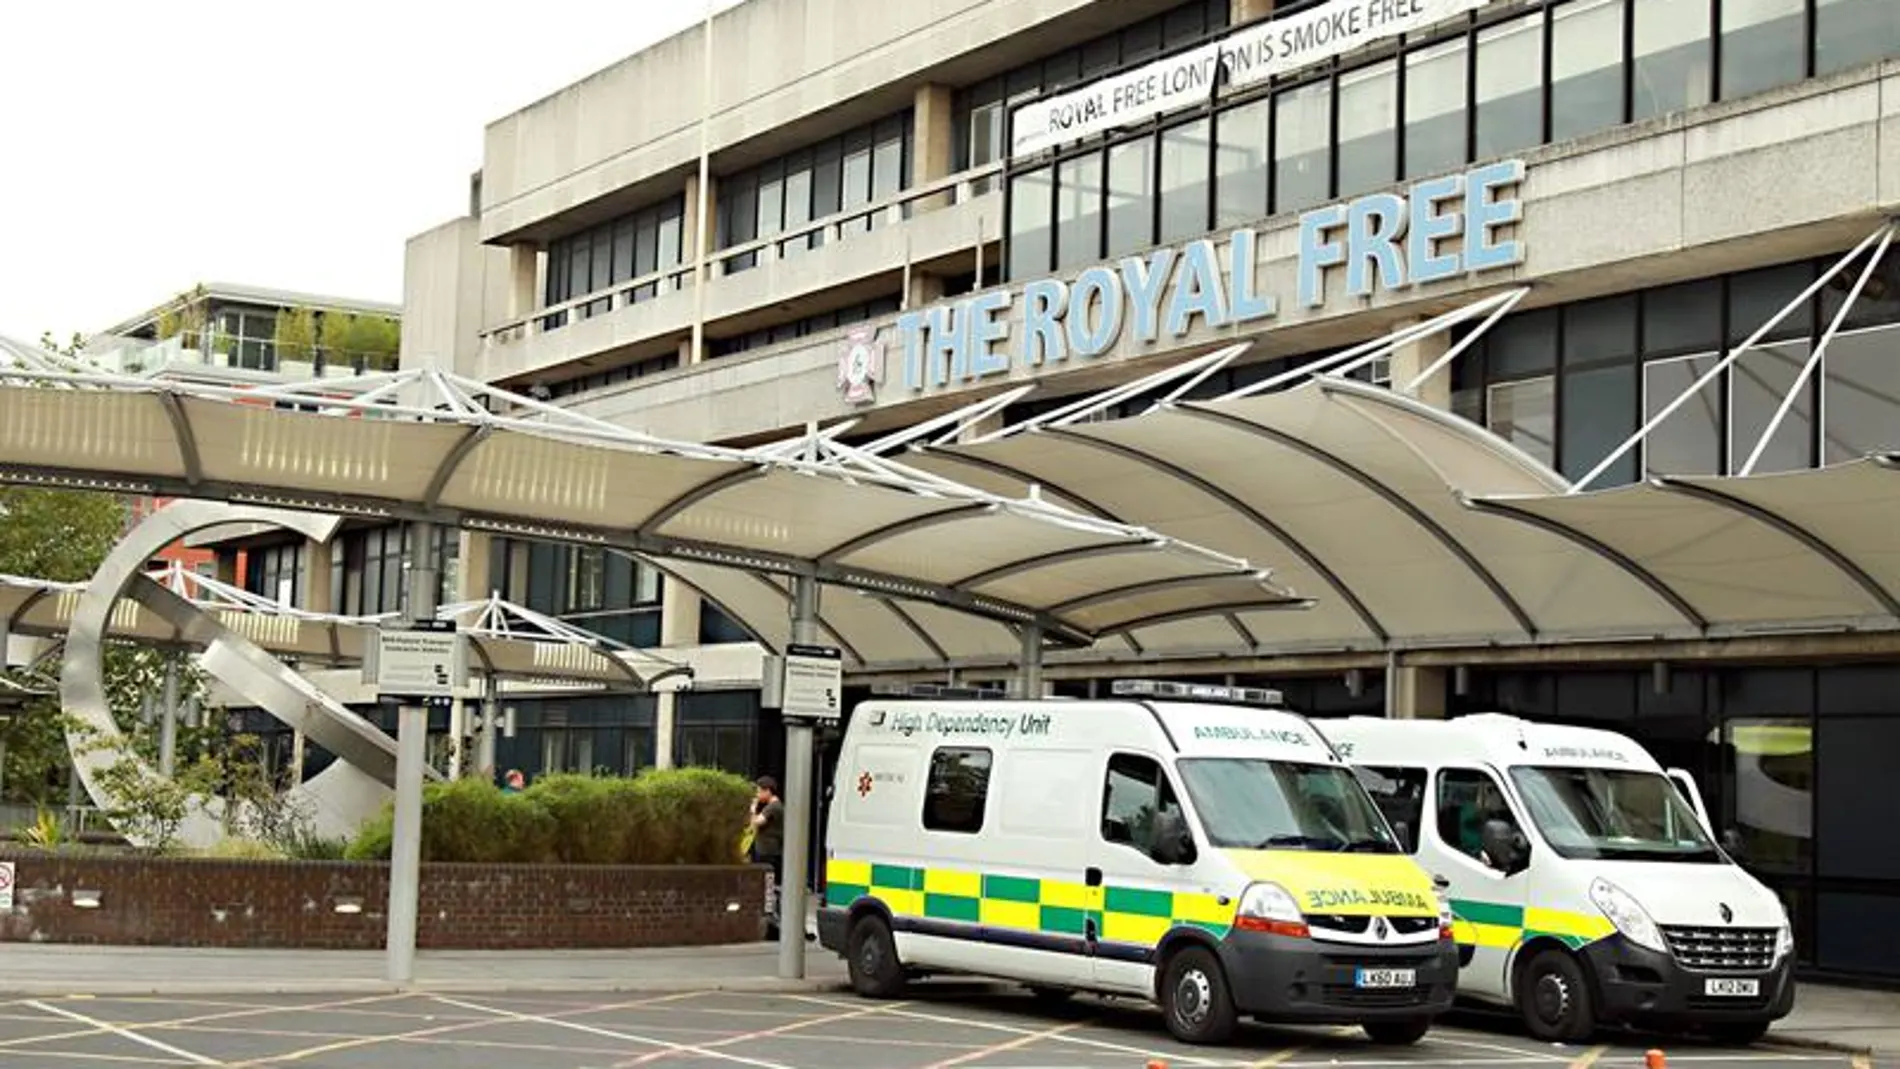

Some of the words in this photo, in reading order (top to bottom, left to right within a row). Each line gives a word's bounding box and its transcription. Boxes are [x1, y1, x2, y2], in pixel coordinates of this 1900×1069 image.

[1048, 93, 1107, 133] ROYAL
[1113, 75, 1155, 113] FREE
[1256, 34, 1274, 65] IS
[1279, 6, 1361, 58] SMOKE
[897, 289, 1013, 391] THE
[1023, 228, 1288, 366] ROYAL
[1298, 158, 1526, 309] FREE
[890, 712, 922, 737] High
[926, 711, 1015, 739] Dependency
[1020, 713, 1051, 735] Unit
[1194, 726, 1311, 746] AMBULANCE
[1544, 747, 1629, 763] AMBULANCE
